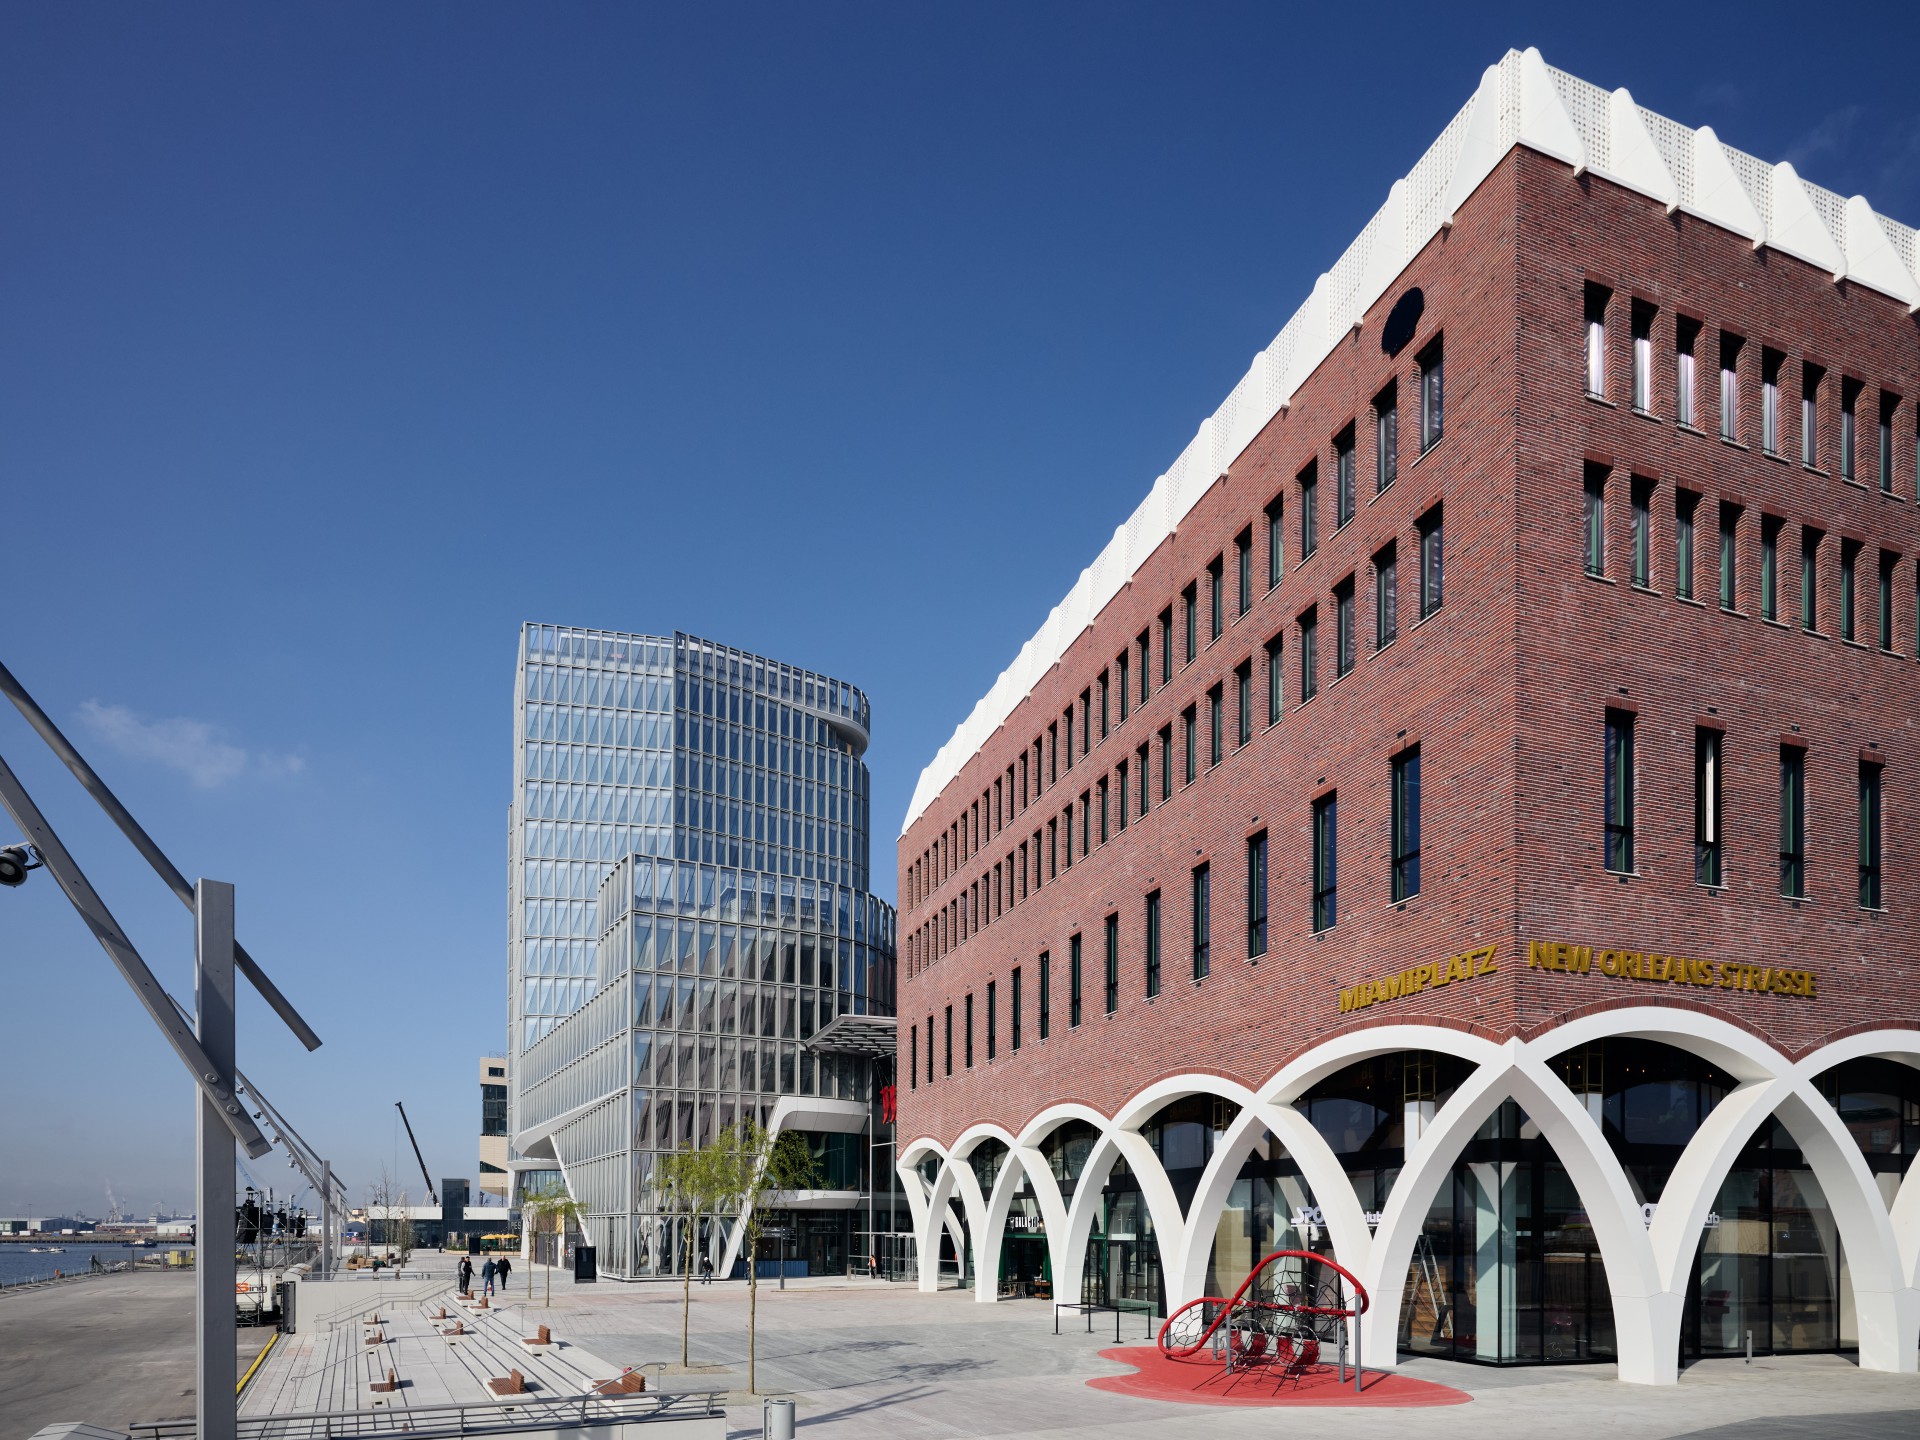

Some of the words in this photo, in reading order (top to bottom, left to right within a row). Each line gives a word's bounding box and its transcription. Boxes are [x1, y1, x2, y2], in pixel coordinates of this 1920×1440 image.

[1339, 944, 1498, 1013] MIAMIPLATZ
[1529, 940, 1593, 974] NEW
[1600, 949, 1714, 987] ORLEANS
[1719, 961, 1817, 998] STRASSE
